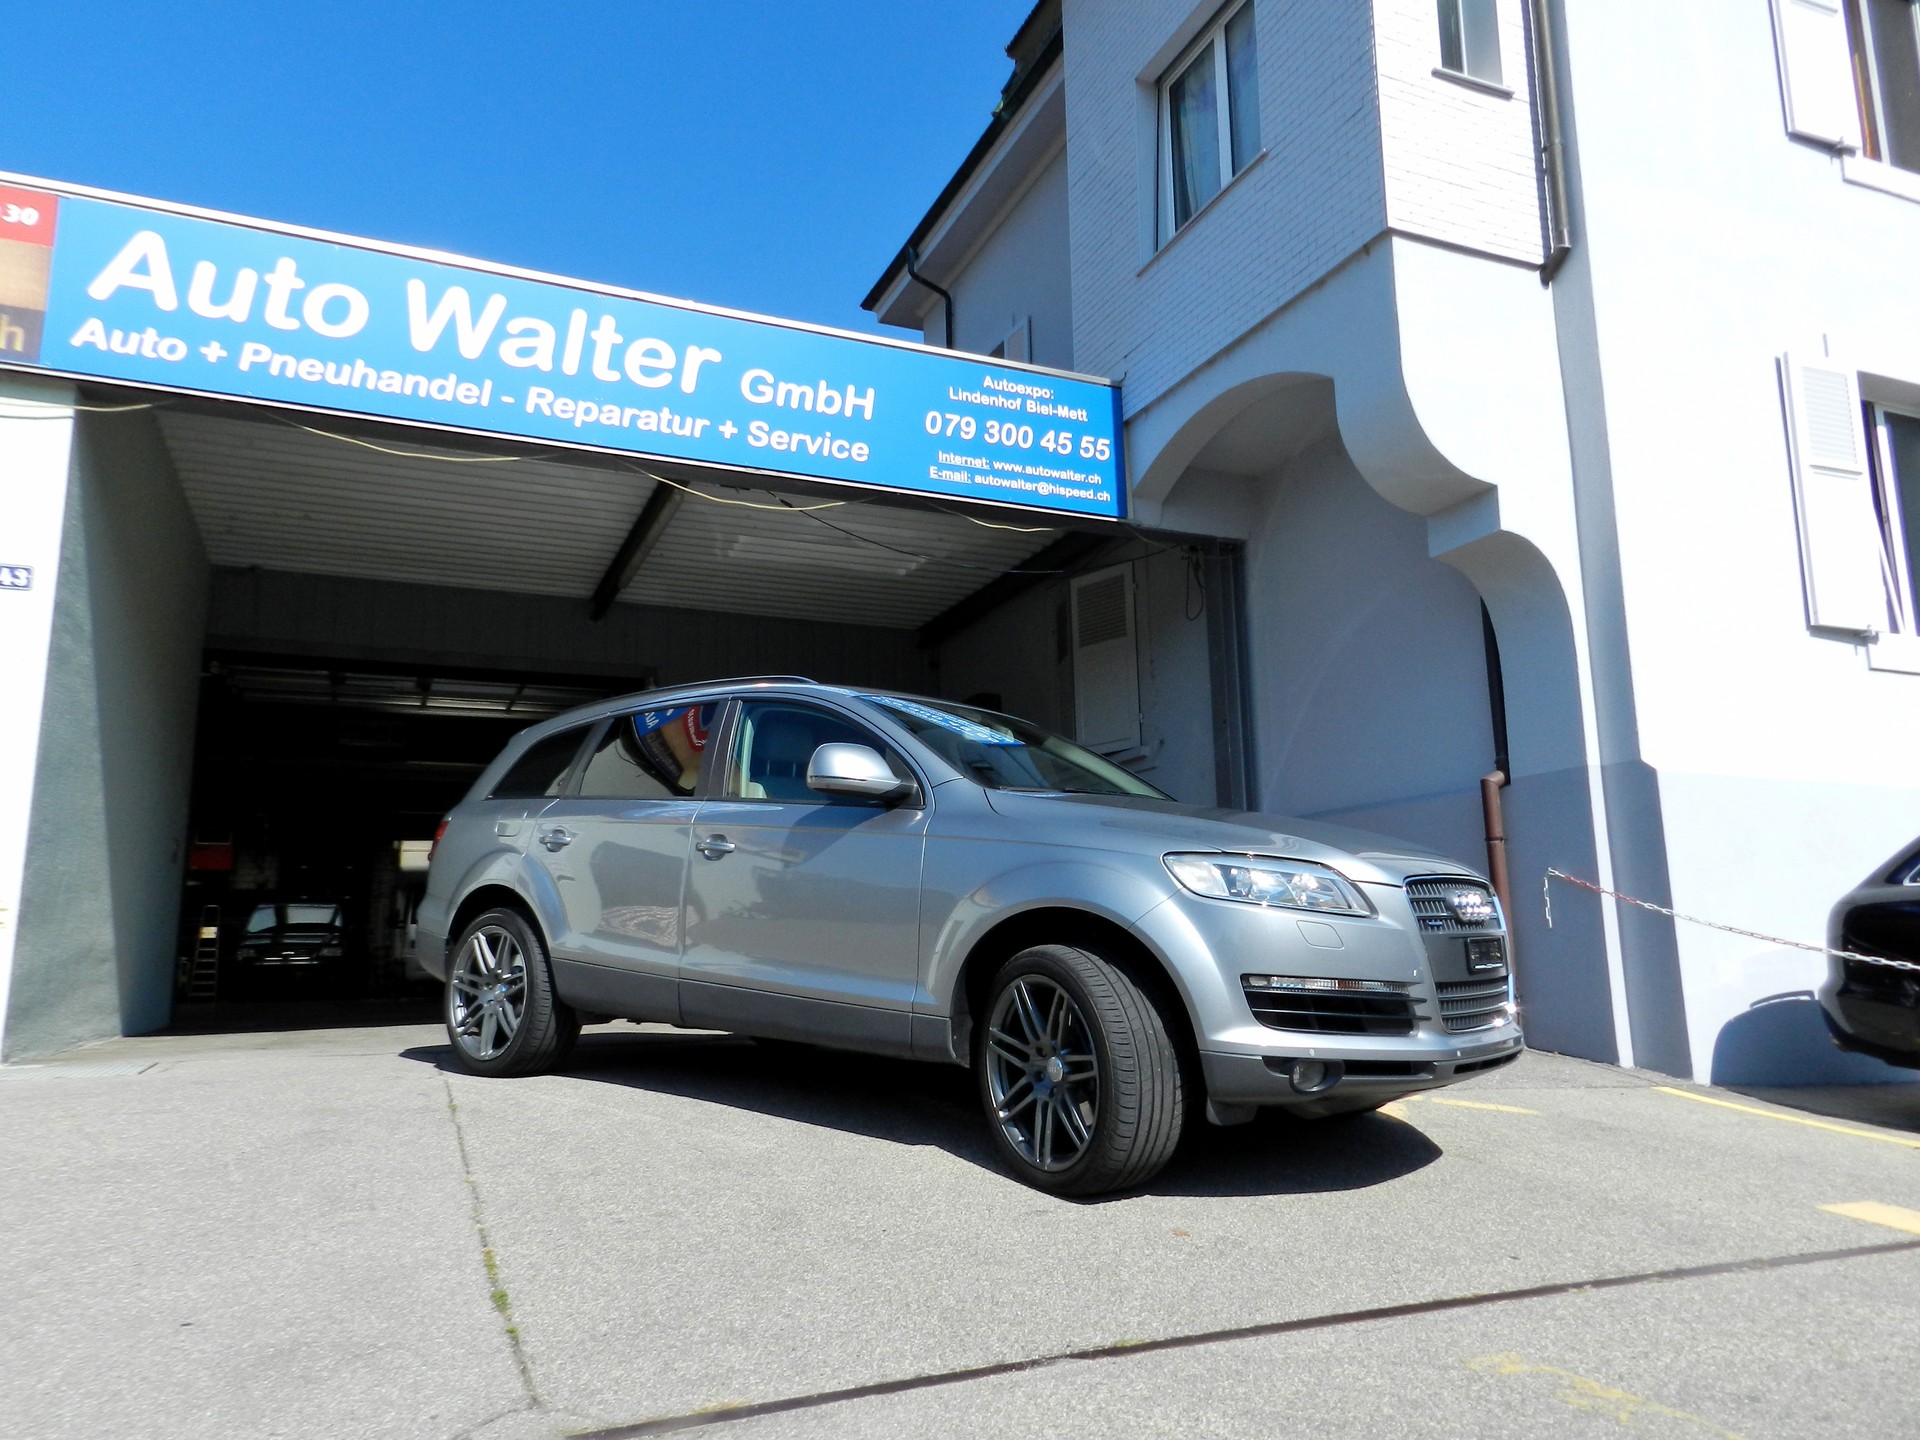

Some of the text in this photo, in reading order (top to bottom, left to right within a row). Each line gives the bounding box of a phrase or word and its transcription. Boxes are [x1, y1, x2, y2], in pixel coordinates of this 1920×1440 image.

[88, 231, 875, 421] Auto Walter GmbH
[70, 318, 187, 362] Auto
[238, 341, 492, 407] Pneuhandel
[525, 386, 709, 440] Reparatur
[746, 420, 870, 463] Service
[949, 386, 1088, 422] Lindenhof Biel-Mett
[983, 375, 1055, 400] Autoexpo:
[925, 410, 1111, 461] 079 300 45 55
[929, 466, 1111, 502] E-mail: autowalter@hispeed.ch
[938, 450, 1102, 485] Internet: www.autowalter.ch
